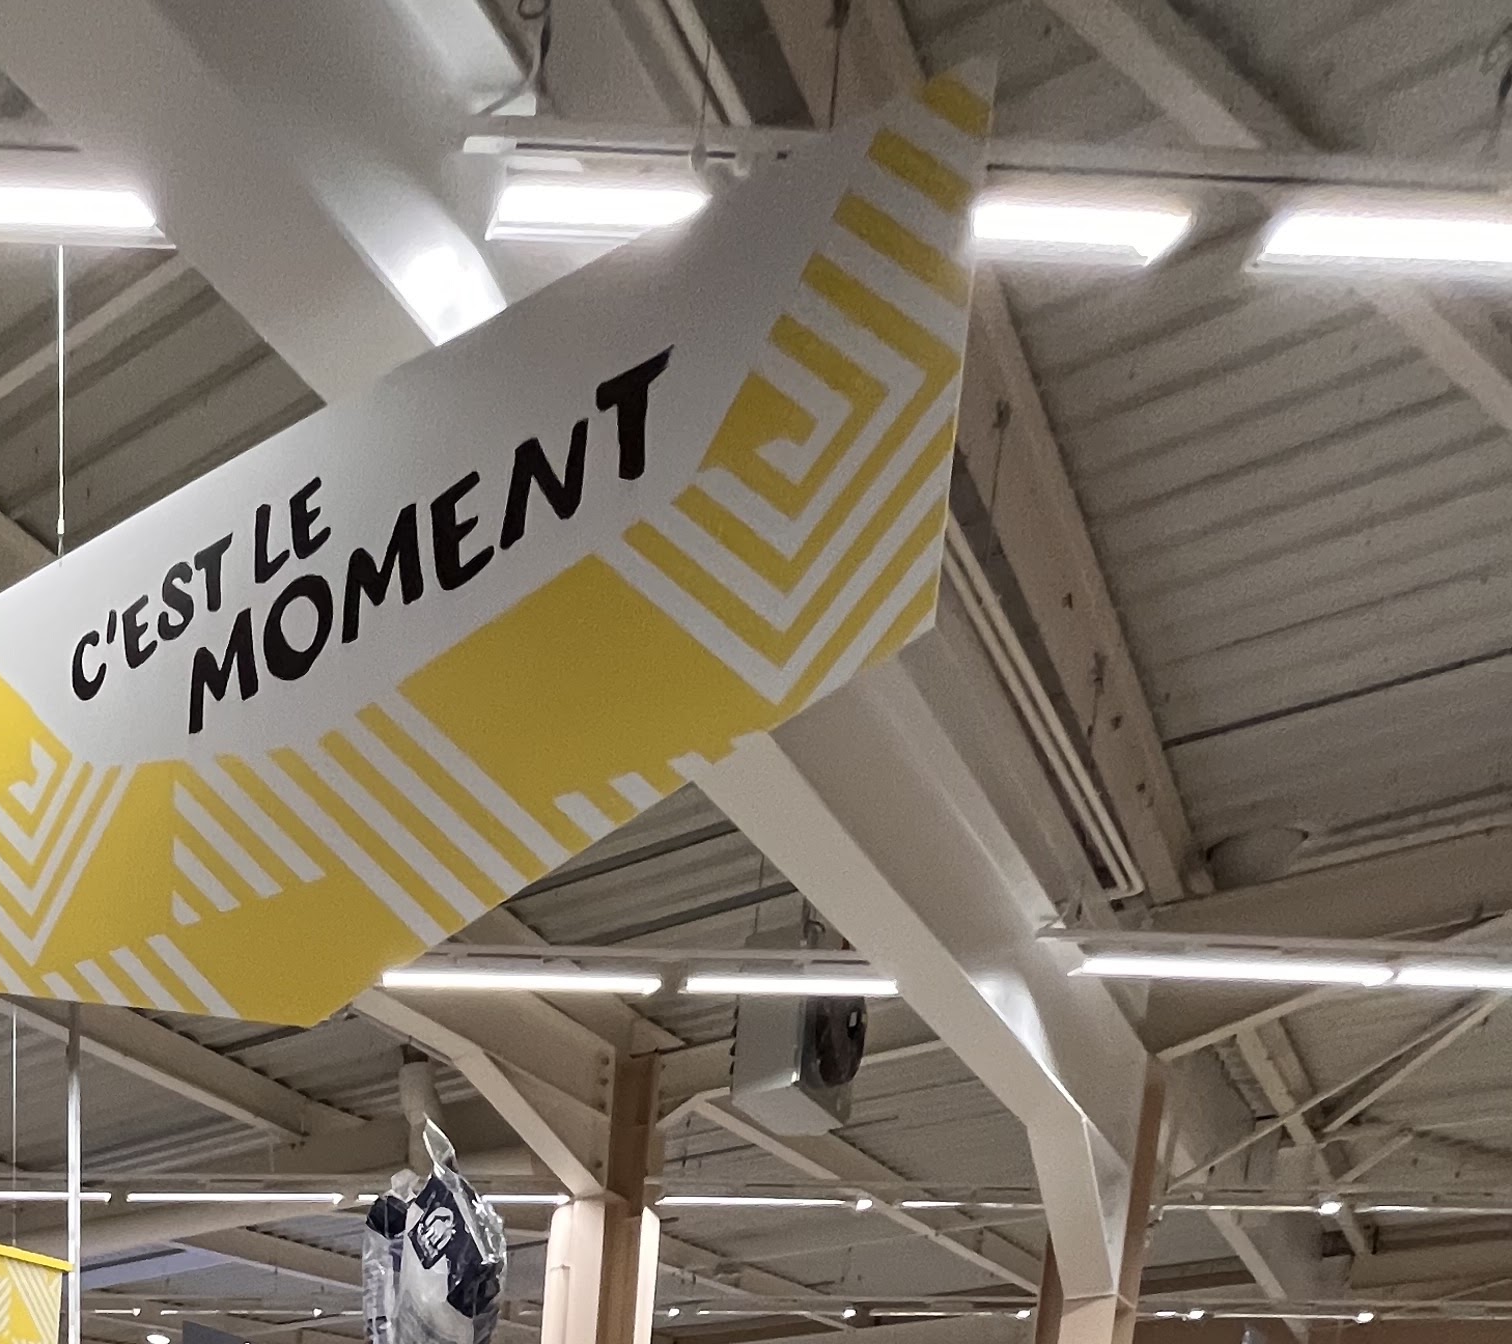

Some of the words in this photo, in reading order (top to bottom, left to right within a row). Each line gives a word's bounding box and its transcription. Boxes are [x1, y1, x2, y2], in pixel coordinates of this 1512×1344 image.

[72, 534, 233, 701] C'EST
[254, 477, 332, 585] LE
[189, 345, 675, 735] MOMENT
